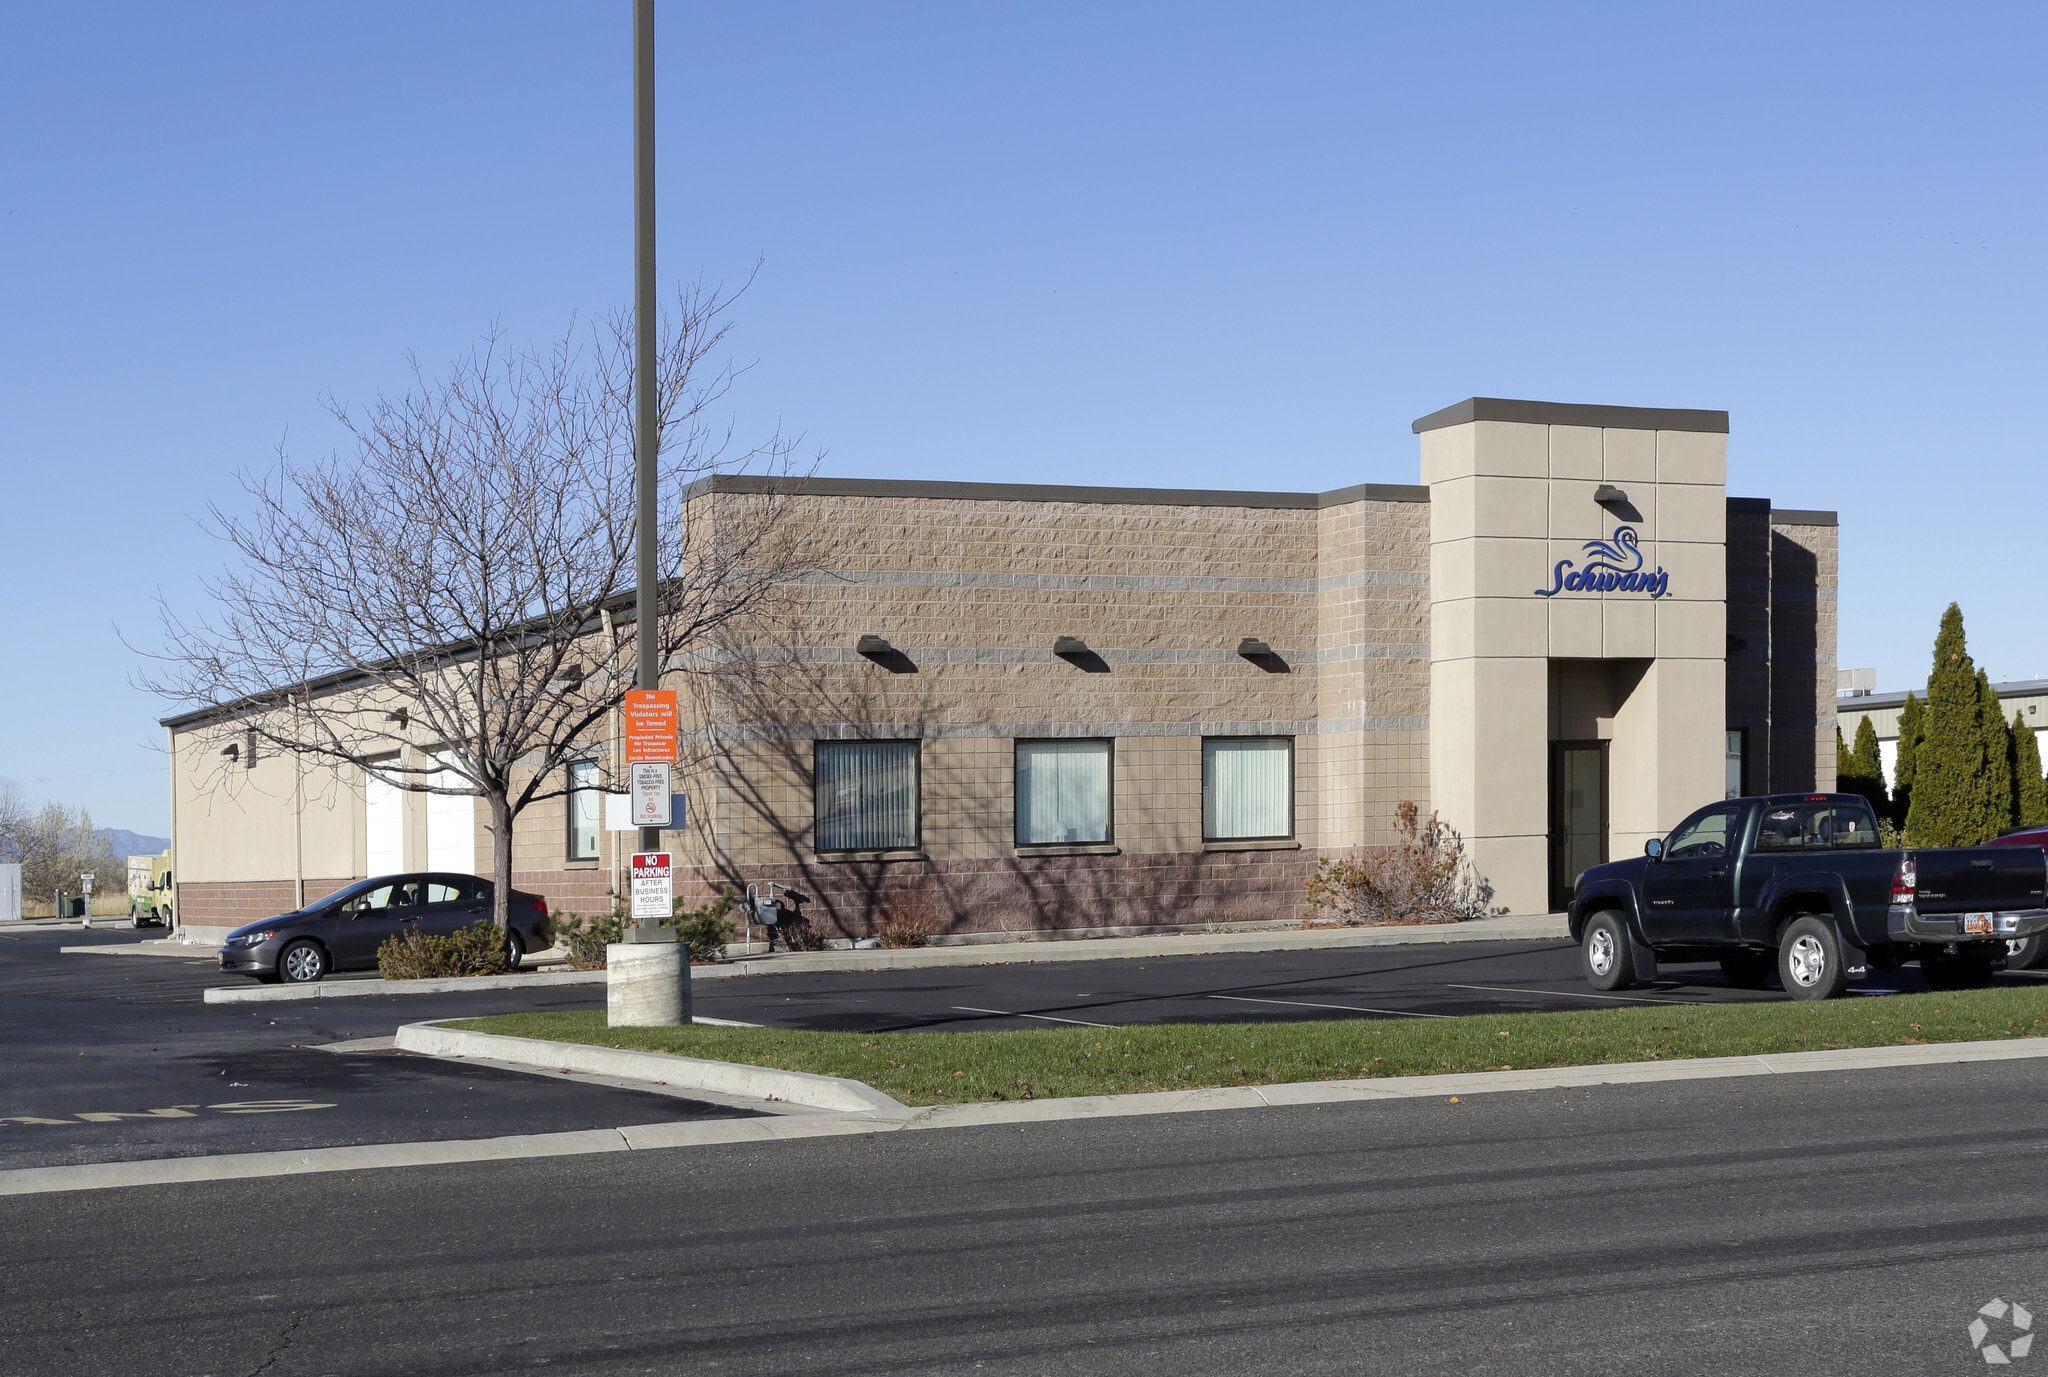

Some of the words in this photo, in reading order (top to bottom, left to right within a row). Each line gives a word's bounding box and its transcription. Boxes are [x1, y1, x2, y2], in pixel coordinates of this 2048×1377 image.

[1534, 559, 1669, 599] Schwan's
[645, 855, 658, 866] NO
[634, 866, 670, 878] PARKING
